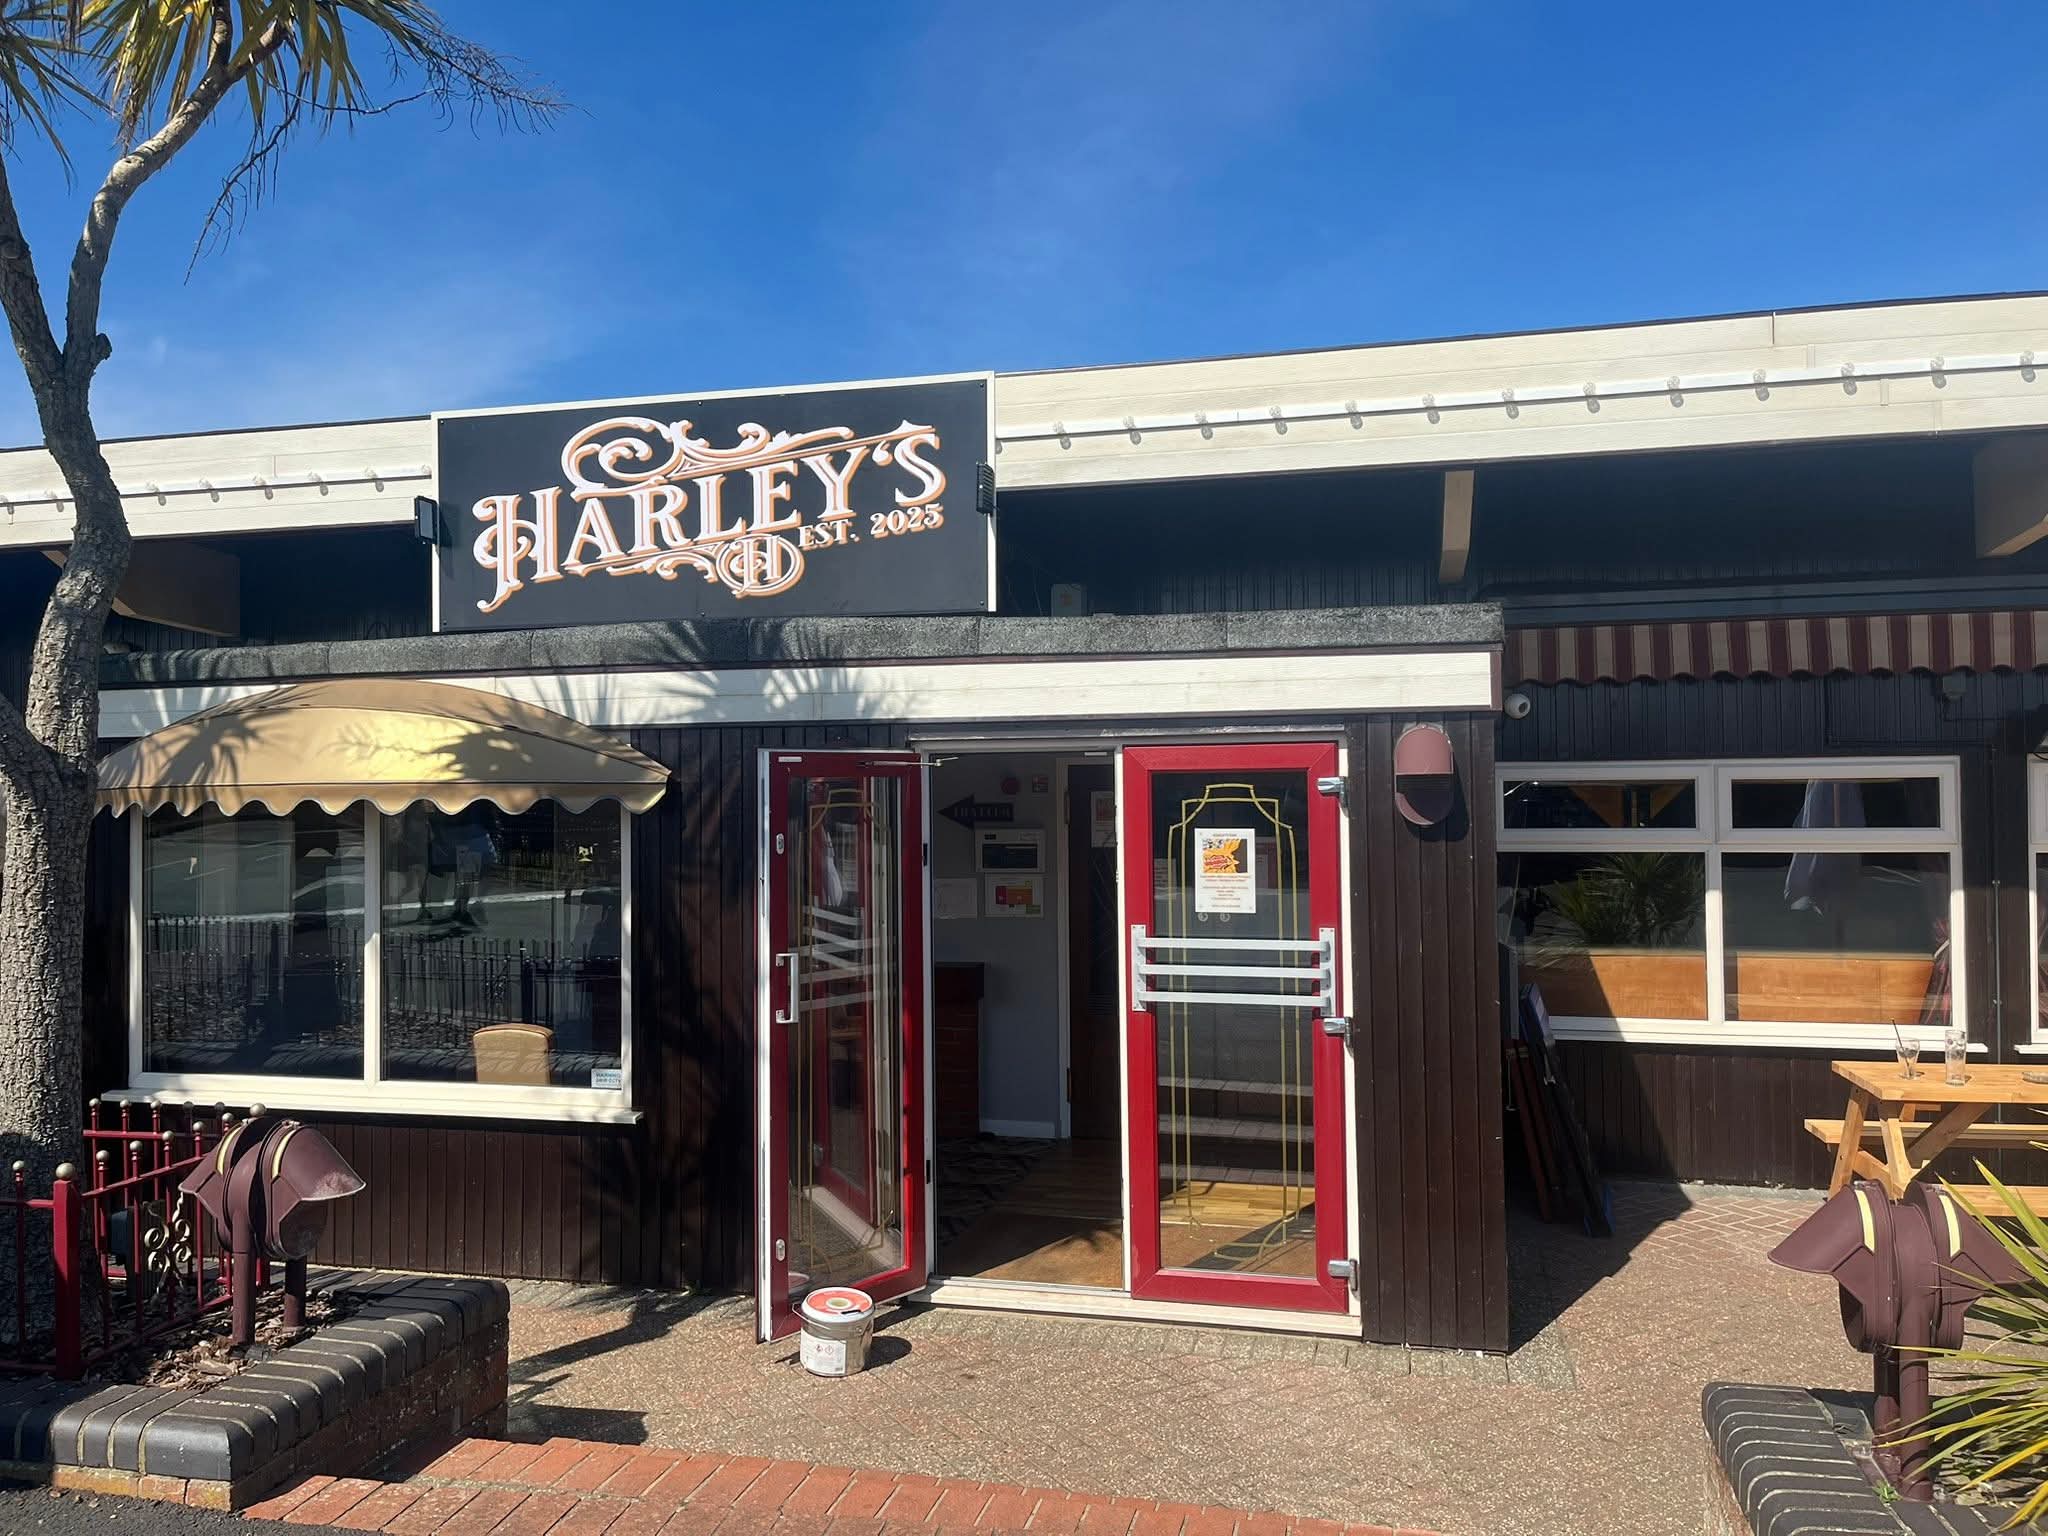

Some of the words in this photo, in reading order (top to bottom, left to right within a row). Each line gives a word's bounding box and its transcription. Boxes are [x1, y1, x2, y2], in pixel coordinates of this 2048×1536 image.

[472, 430, 946, 612] HARLEY'S
[798, 517, 860, 550] EST.
[869, 502, 944, 538] 2025
